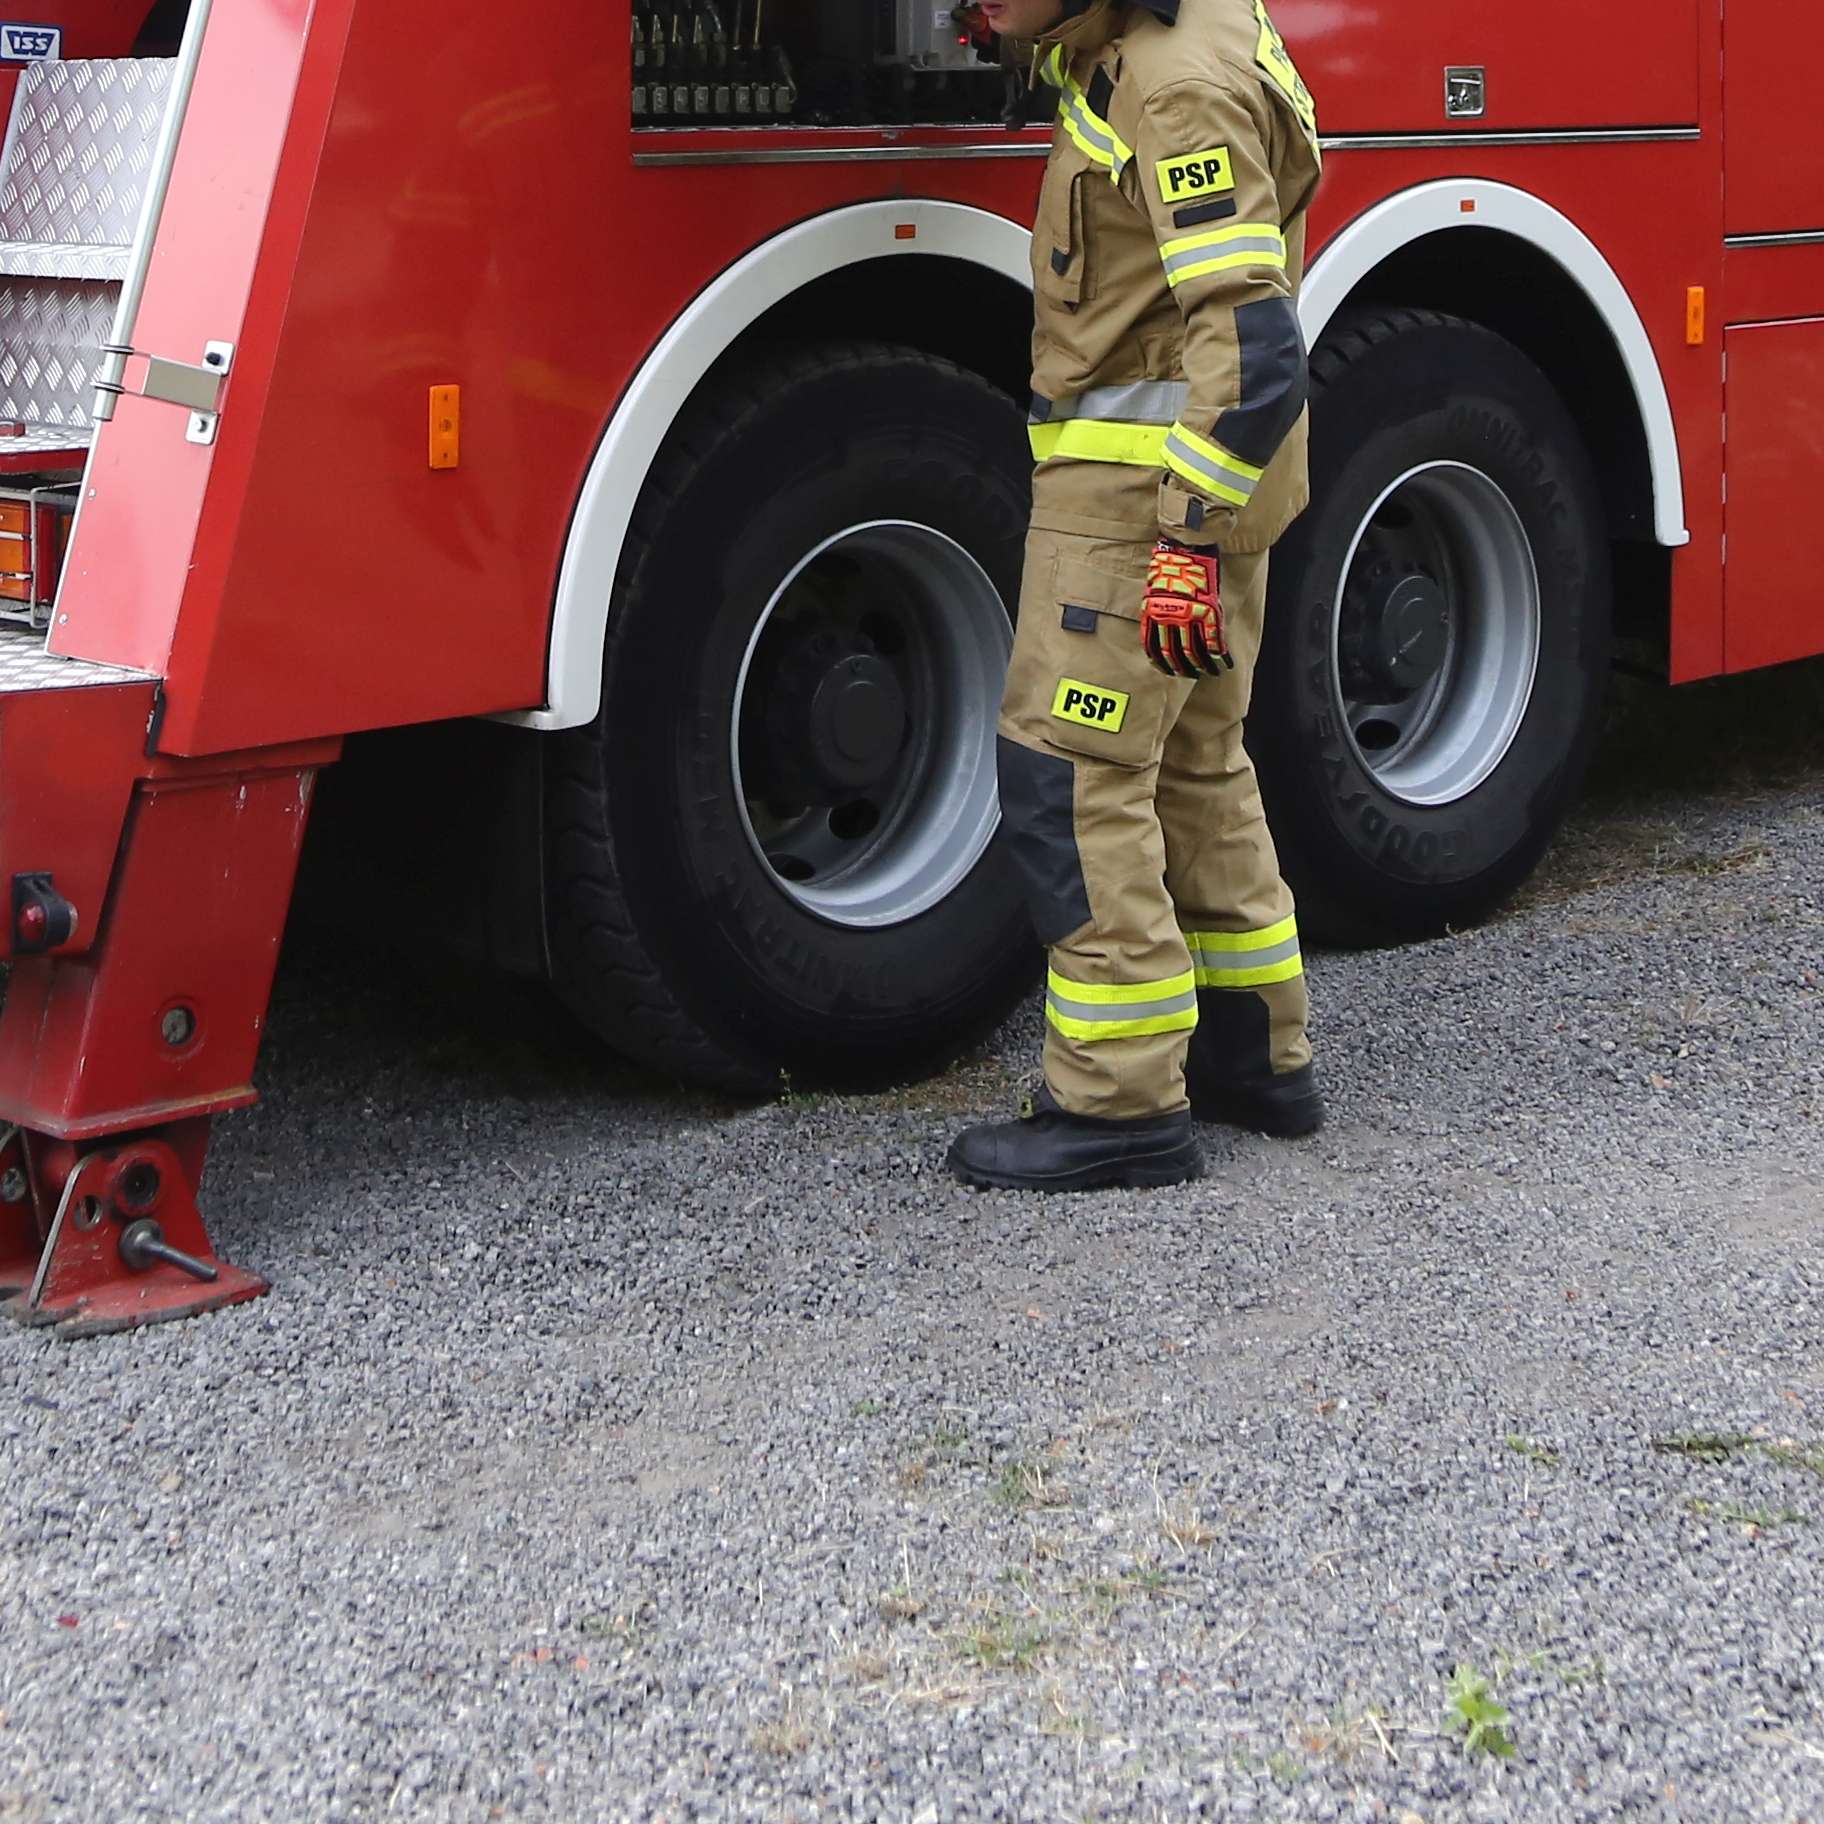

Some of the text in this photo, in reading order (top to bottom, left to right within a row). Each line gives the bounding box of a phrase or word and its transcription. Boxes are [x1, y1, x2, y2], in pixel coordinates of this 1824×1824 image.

[13, 36, 48, 51] ISS
[1168, 159, 1221, 192] PSP
[1062, 688, 1117, 722] PSP
